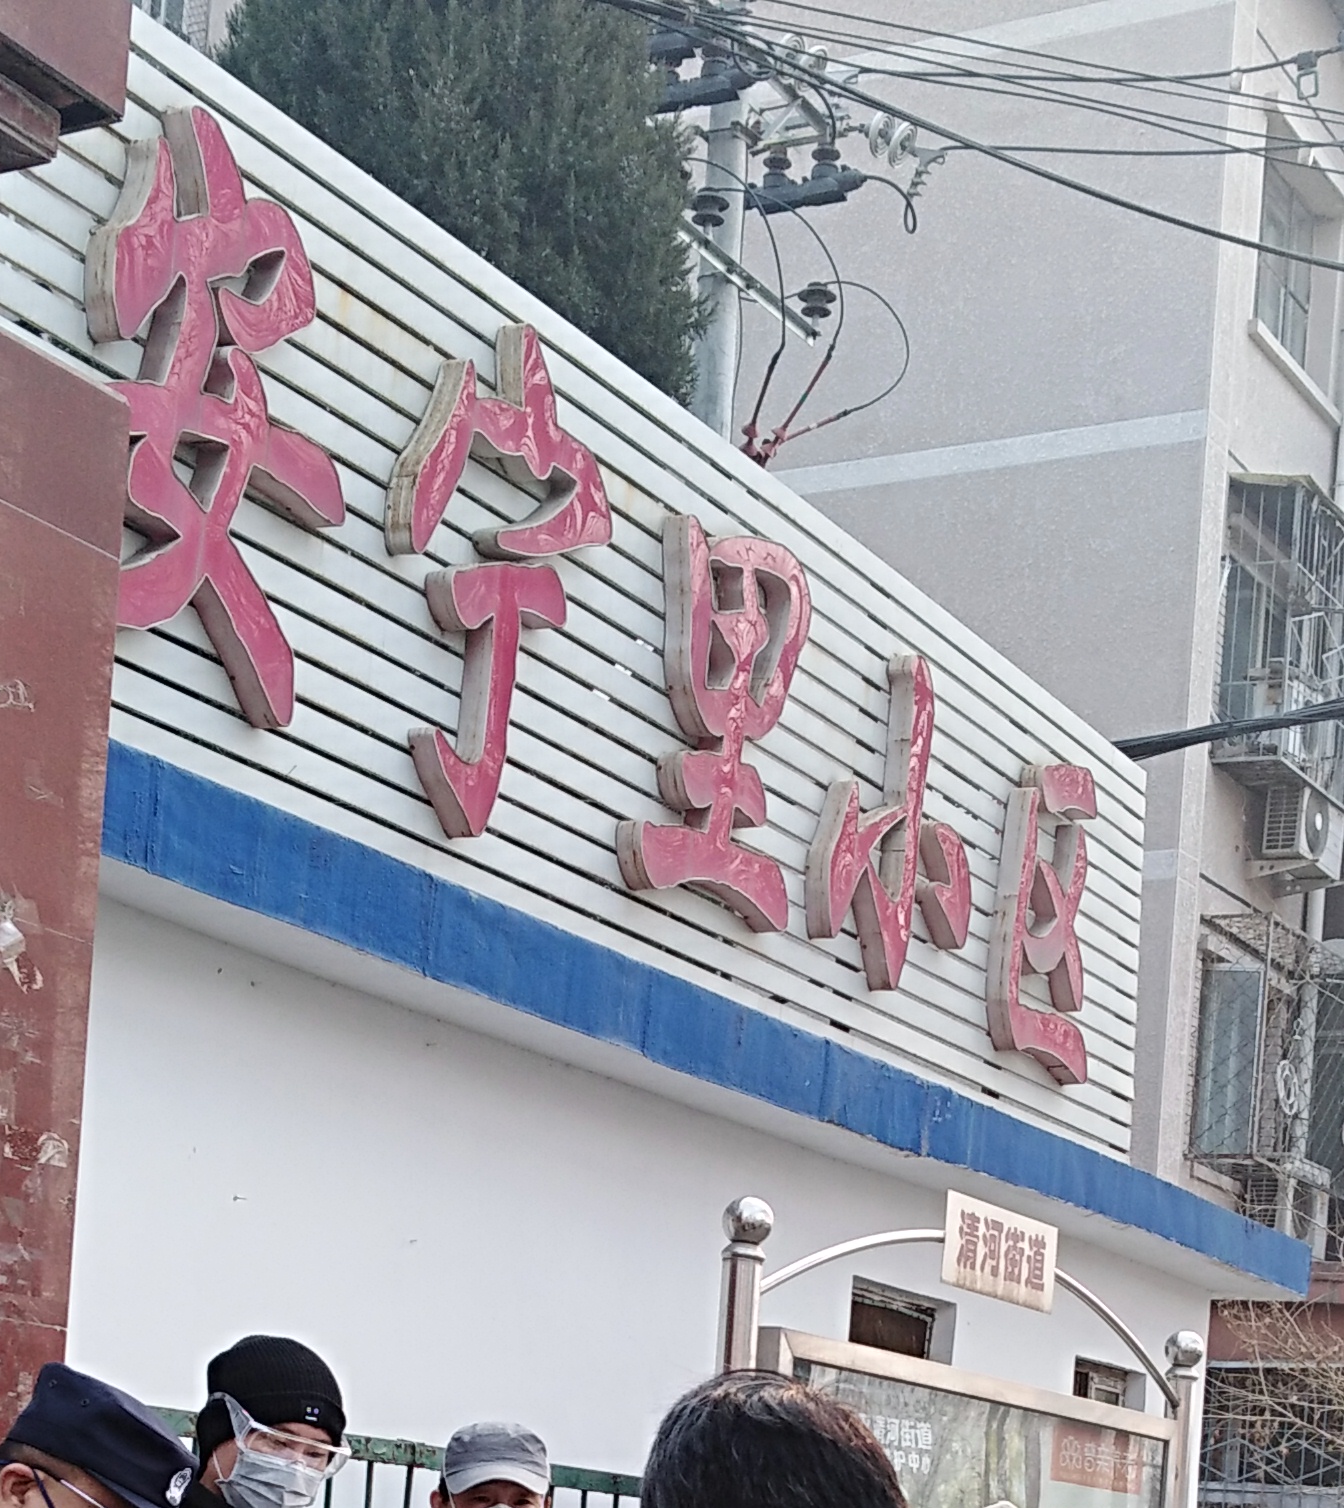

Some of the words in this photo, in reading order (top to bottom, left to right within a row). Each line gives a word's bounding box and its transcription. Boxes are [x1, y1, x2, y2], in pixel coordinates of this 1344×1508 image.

[86, 105, 1096, 1086] 安宁里小区
[956, 1208, 1048, 1292] 清河街道
